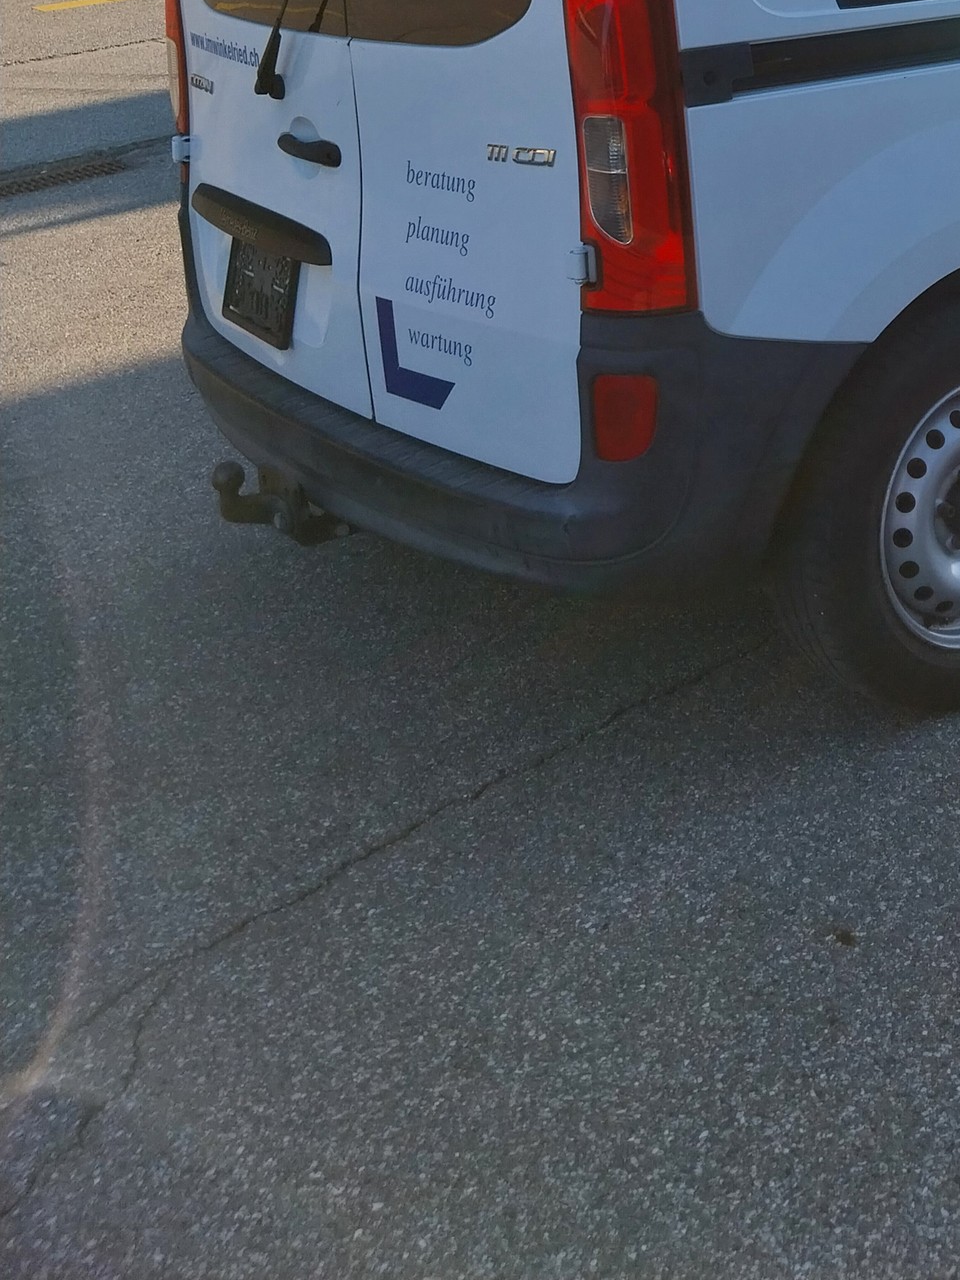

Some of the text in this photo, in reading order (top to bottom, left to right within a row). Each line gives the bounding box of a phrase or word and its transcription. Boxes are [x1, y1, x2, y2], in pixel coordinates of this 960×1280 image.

[190, 32, 260, 68] www.imwinkelried.ch
[512, 147, 557, 167] CDI
[406, 160, 476, 202] beratung
[405, 216, 470, 256] planung
[405, 274, 497, 319] ausführung
[408, 327, 473, 367] wartung
